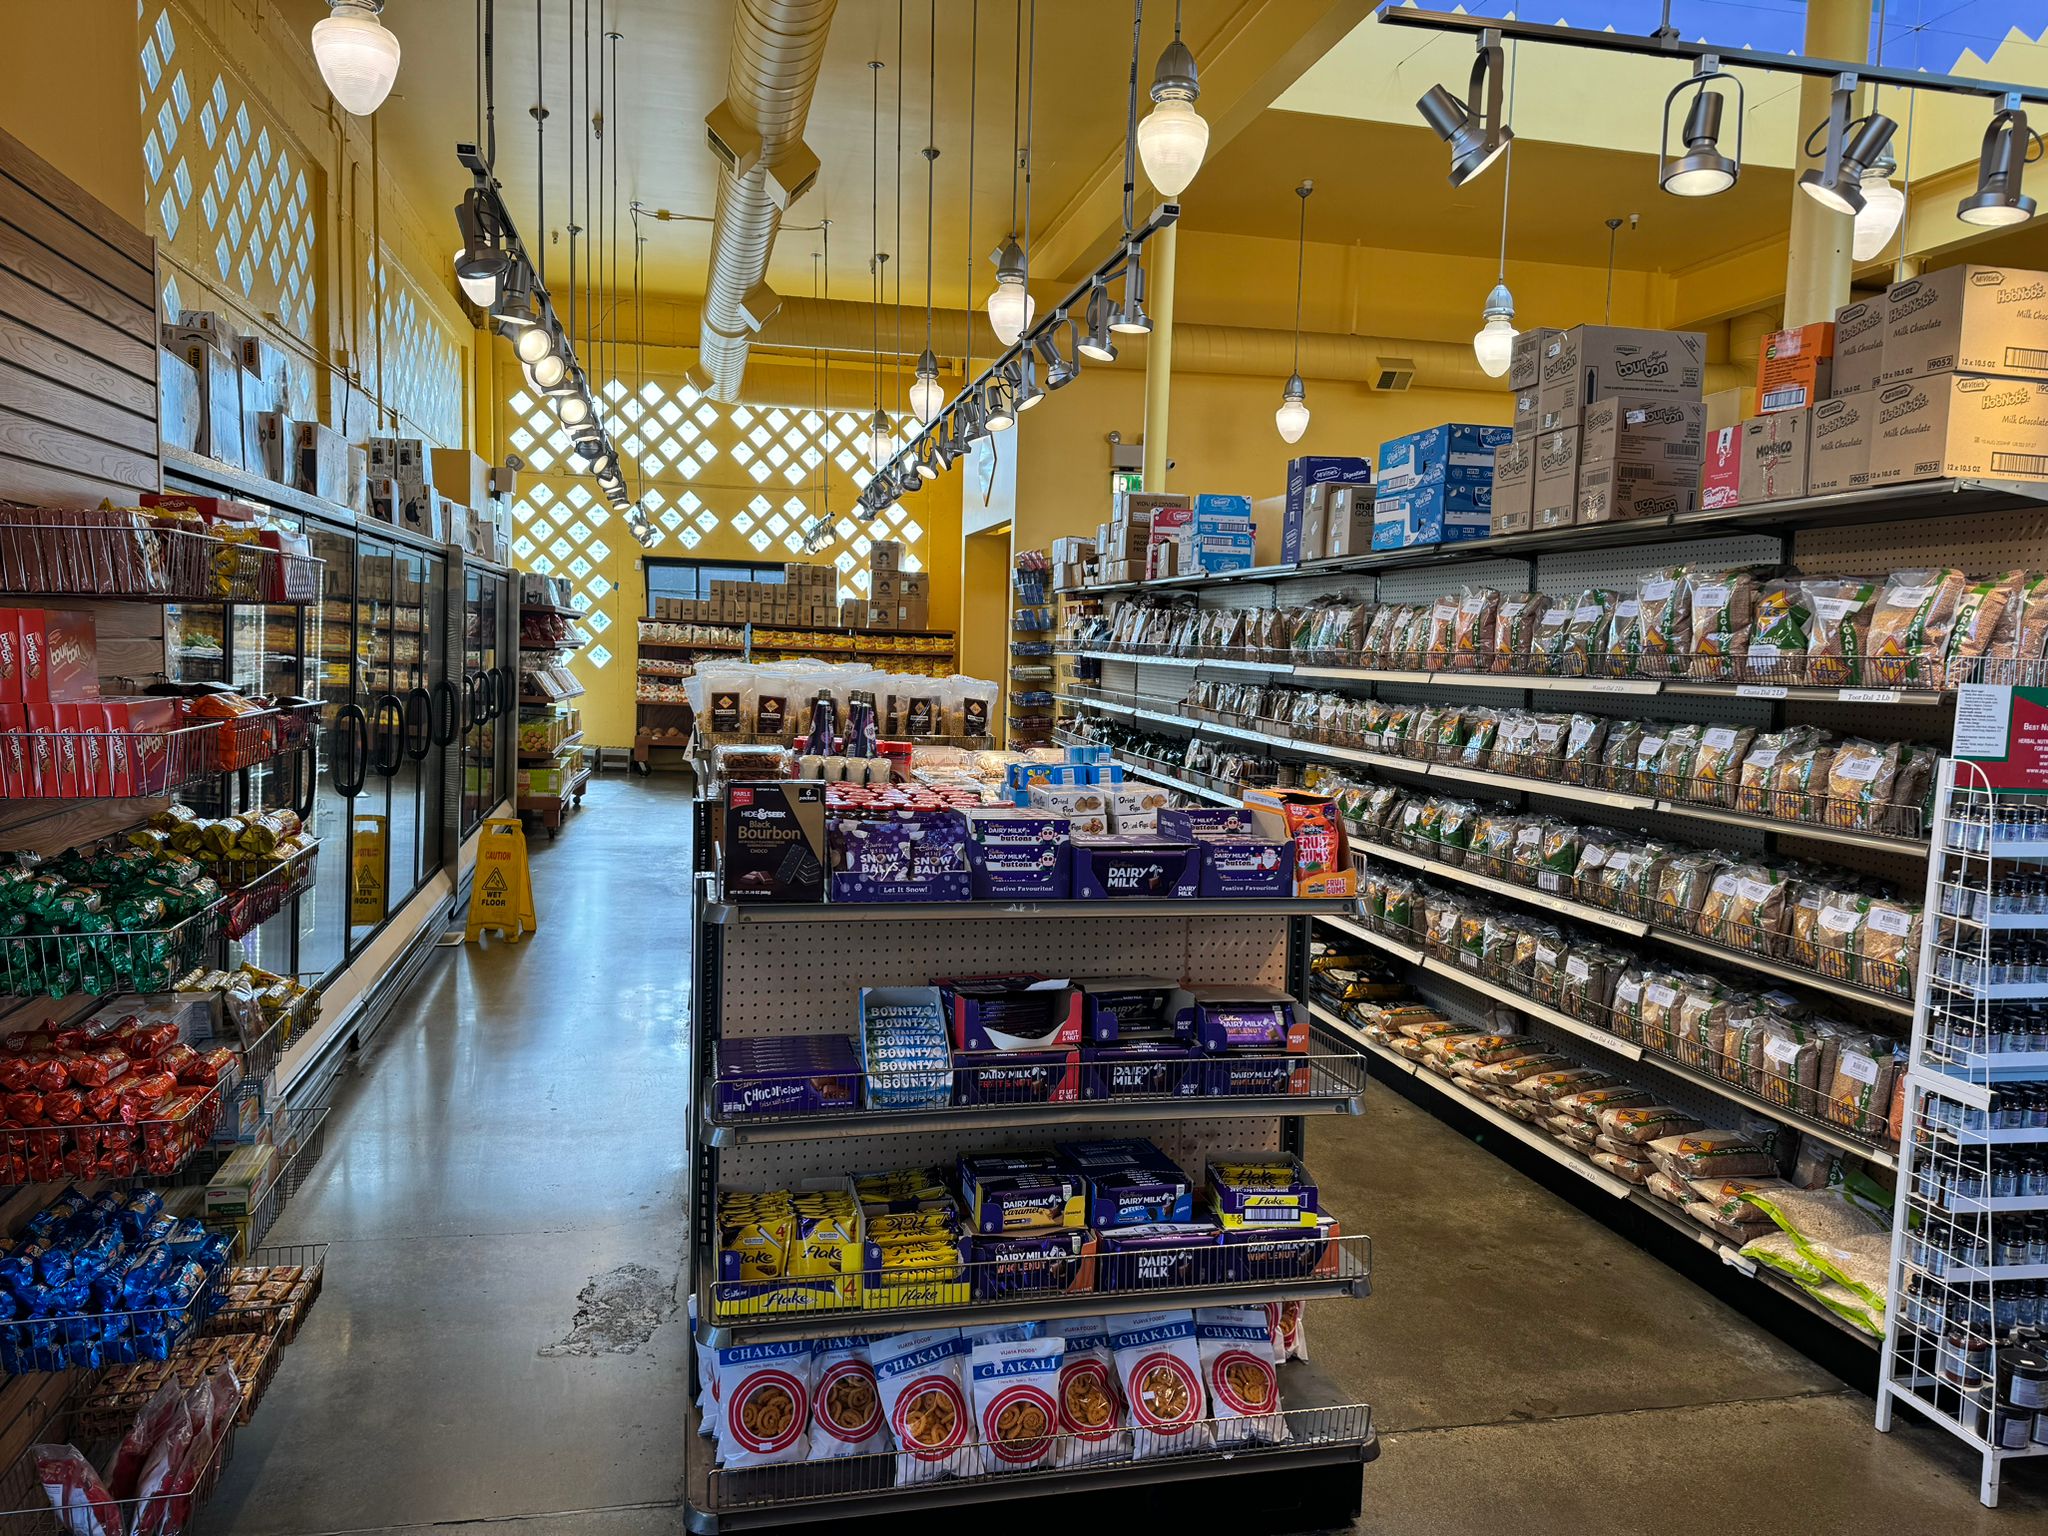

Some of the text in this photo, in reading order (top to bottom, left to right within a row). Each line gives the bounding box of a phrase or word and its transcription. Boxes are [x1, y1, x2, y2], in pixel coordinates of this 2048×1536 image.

[2017, 309, 2032, 319] Milk
[1893, 319, 1942, 338] Milk Chocolate
[1928, 357, 1952, 369] 19052
[1961, 358, 1968, 366] 12
[1974, 359, 1986, 367] 10.5
[1879, 392, 1929, 424] HobNobs
[1643, 407, 1684, 425] ourbon
[2002, 415, 2048, 427] Milk Chocolate
[1883, 424, 1932, 439] Milk Chocolate
[1915, 463, 1938, 472] 19052
[1947, 463, 1953, 471] 12
[1960, 464, 1972, 472] 10.5
[1908, 598, 1929, 655] ORGANIC
[50, 643, 81, 666] bourbon
[2024, 722, 2040, 731] BEST
[1051, 797, 1069, 805] Dried
[1118, 796, 1136, 804] Dried
[1129, 804, 1141, 812] Figs
[749, 820, 771, 828] Black
[1071, 823, 1081, 831] Figs
[738, 826, 800, 840] Bourbon
[1000, 834, 1032, 842] buttons
[1296, 836, 1330, 849] FRUIT
[485, 851, 511, 860] CAUTION
[860, 853, 898, 862] SNOW
[913, 856, 951, 865] SNOW
[1296, 849, 1330, 863] GUMS
[1107, 867, 1149, 878] DAIRY
[1107, 877, 1140, 888] MILK
[1326, 879, 1345, 887] FRUIT
[1326, 886, 1346, 895] GUMS
[871, 1006, 922, 1016] BOUNTY
[876, 1018, 928, 1028] BOUNTY
[877, 1036, 930, 1046] BOUNTY
[878, 1048, 931, 1058] BOUNTY
[880, 1060, 933, 1071] BOUNTY
[1113, 1065, 1153, 1076] DAIRY
[883, 1077, 935, 1088] BOUNTY
[1113, 1076, 1143, 1086] MILK
[1003, 1197, 1050, 1209] DAIRY MILK
[1119, 1195, 1163, 1205] DAIRY MILK
[1255, 1196, 1284, 1205] flake
[1003, 1207, 1041, 1217] Caramel
[1120, 1205, 1145, 1214] OREO
[776, 1226, 785, 1238] 4
[740, 1250, 775, 1264] lake
[801, 1245, 842, 1259] flake
[1024, 1251, 1051, 1260] MILK
[1138, 1256, 1177, 1267] DAIRY
[1138, 1266, 1169, 1279] MILK
[843, 1279, 857, 1296] 4
[763, 1290, 809, 1307] flake
[900, 1288, 938, 1304] flake
[1119, 1324, 1188, 1347] CHAKALI
[1204, 1326, 1261, 1339] CHAKALI
[728, 1342, 803, 1362] CHAKALI
[881, 1342, 954, 1373] CHAKALI
[981, 1357, 1057, 1377] CHAKALI
